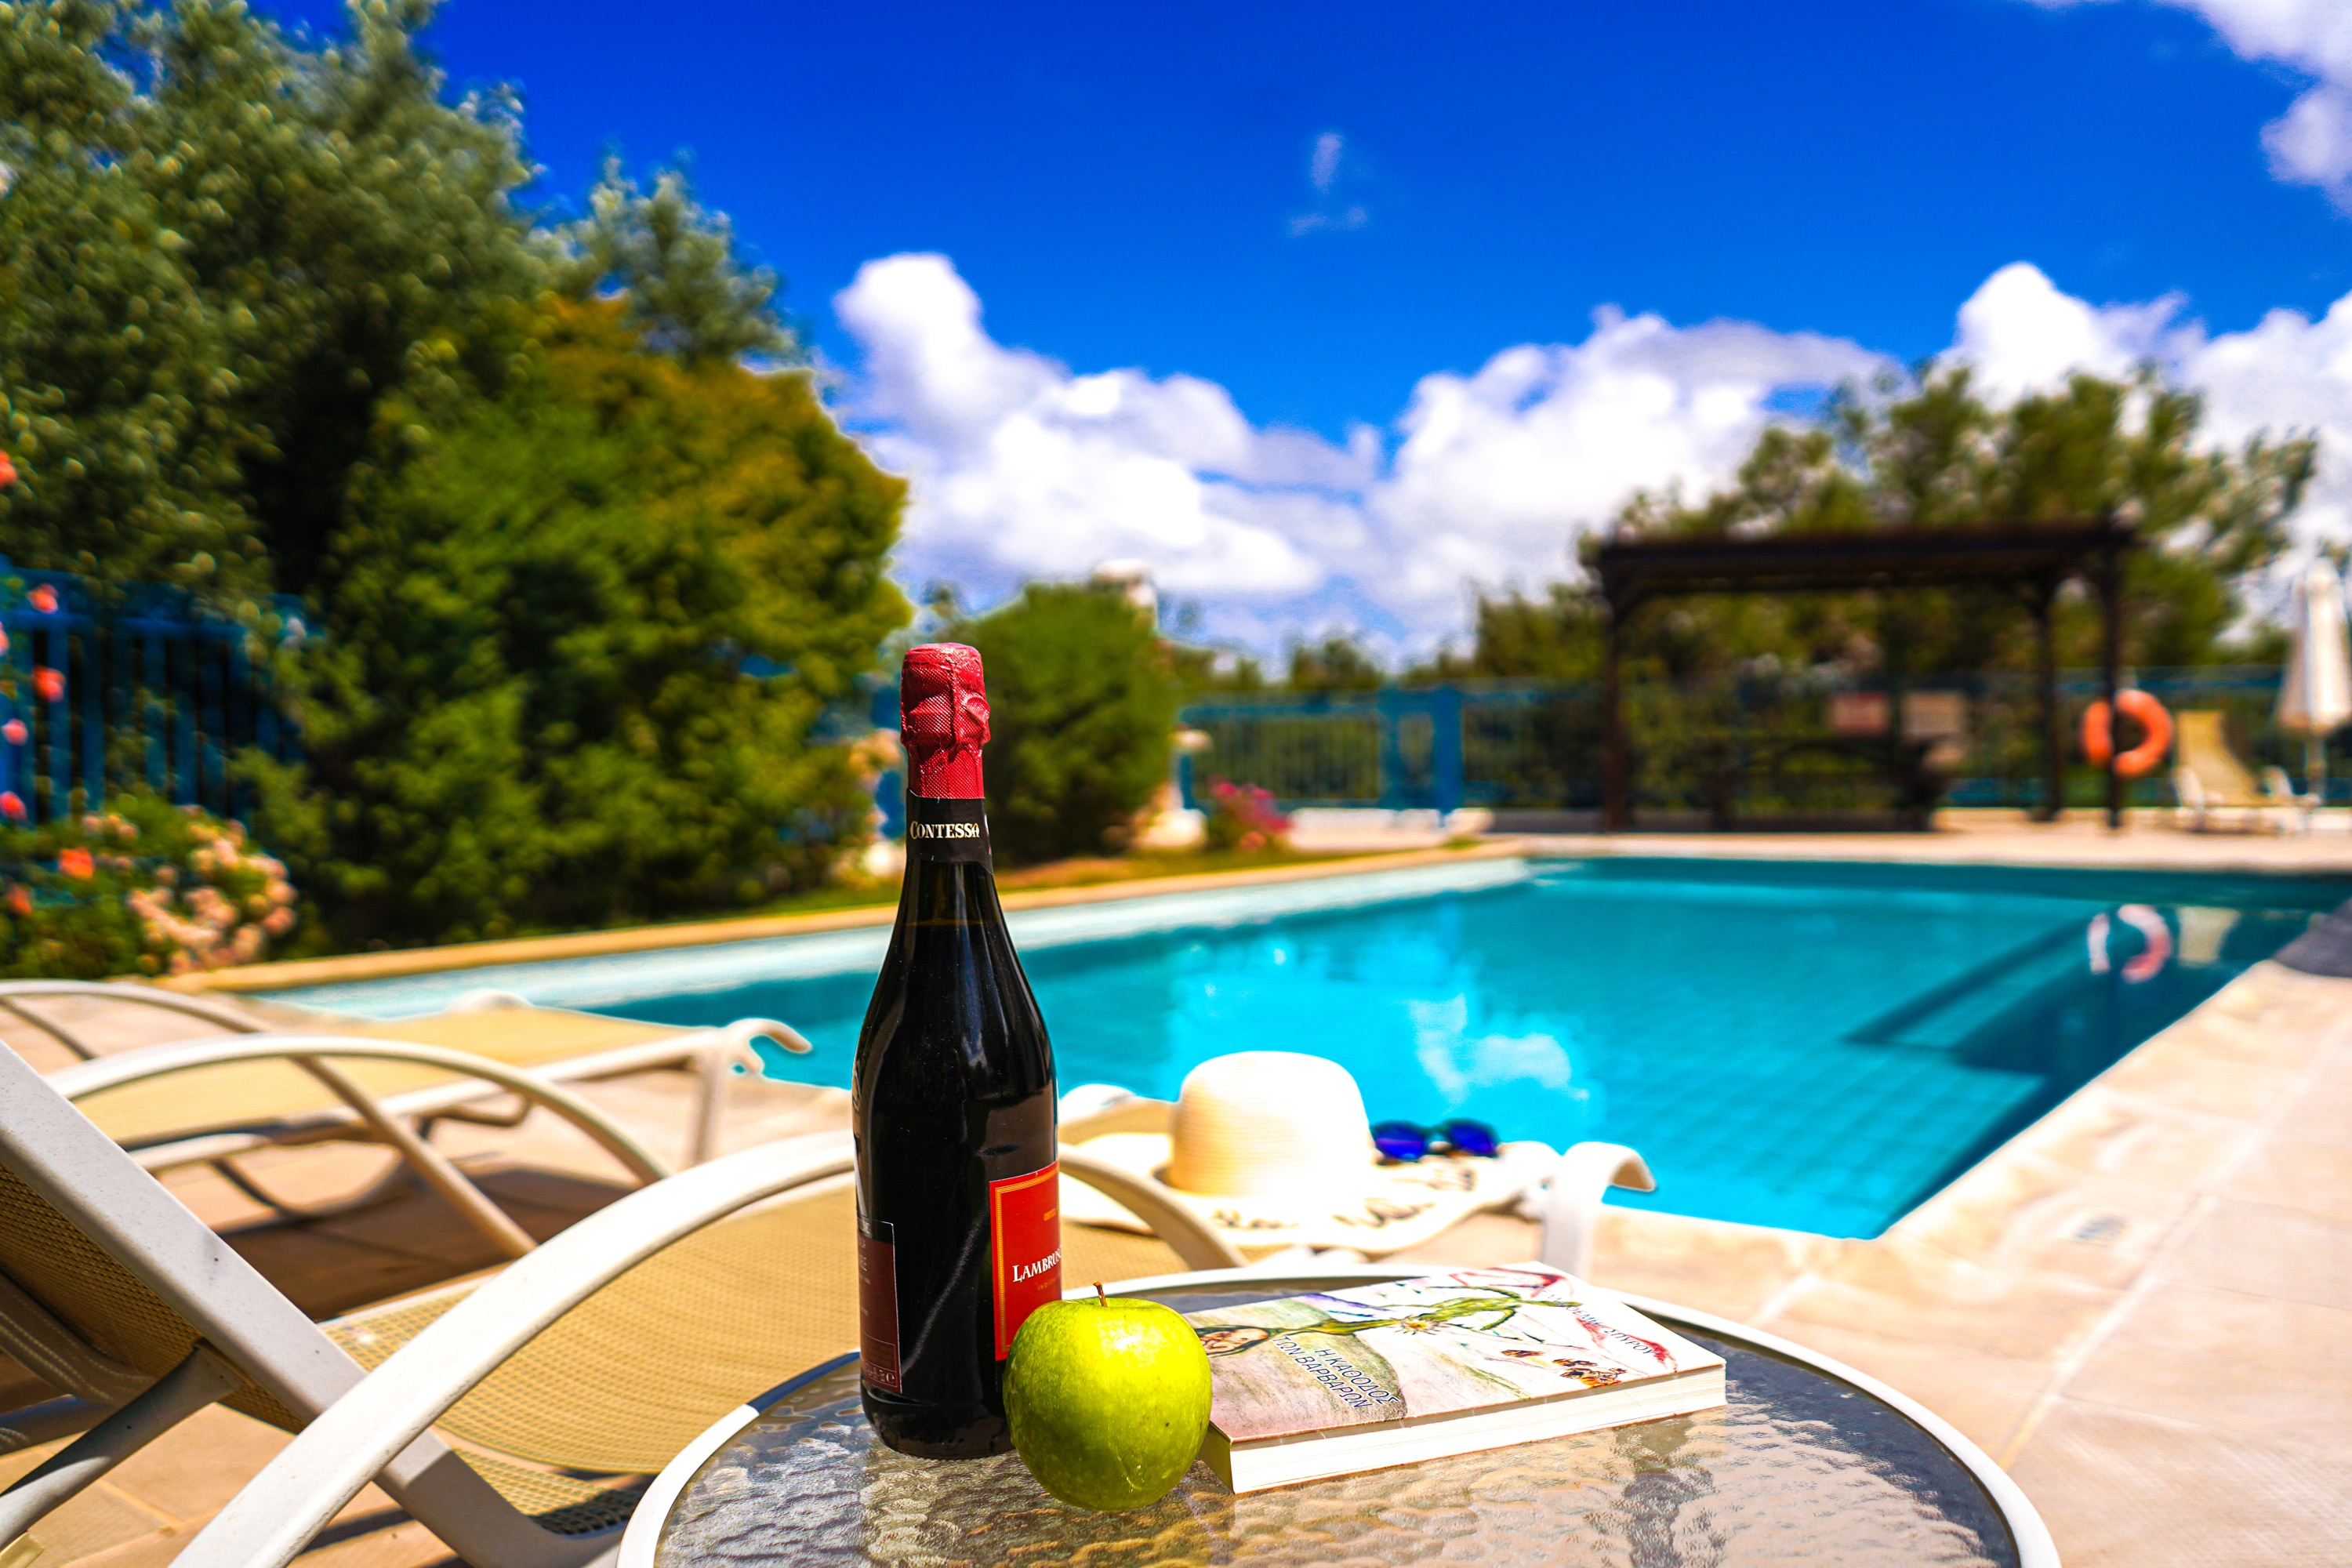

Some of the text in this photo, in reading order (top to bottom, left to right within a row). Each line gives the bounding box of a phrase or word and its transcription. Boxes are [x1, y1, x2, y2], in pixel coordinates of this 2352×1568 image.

[909, 820, 980, 840] CONTESSA
[1272, 1335, 1373, 1409] ΤΩΝ ΒΑΡΒΑΡΩΝ
[1315, 1348, 1401, 1405] Η ΚΑΘΟΔΟΣ
